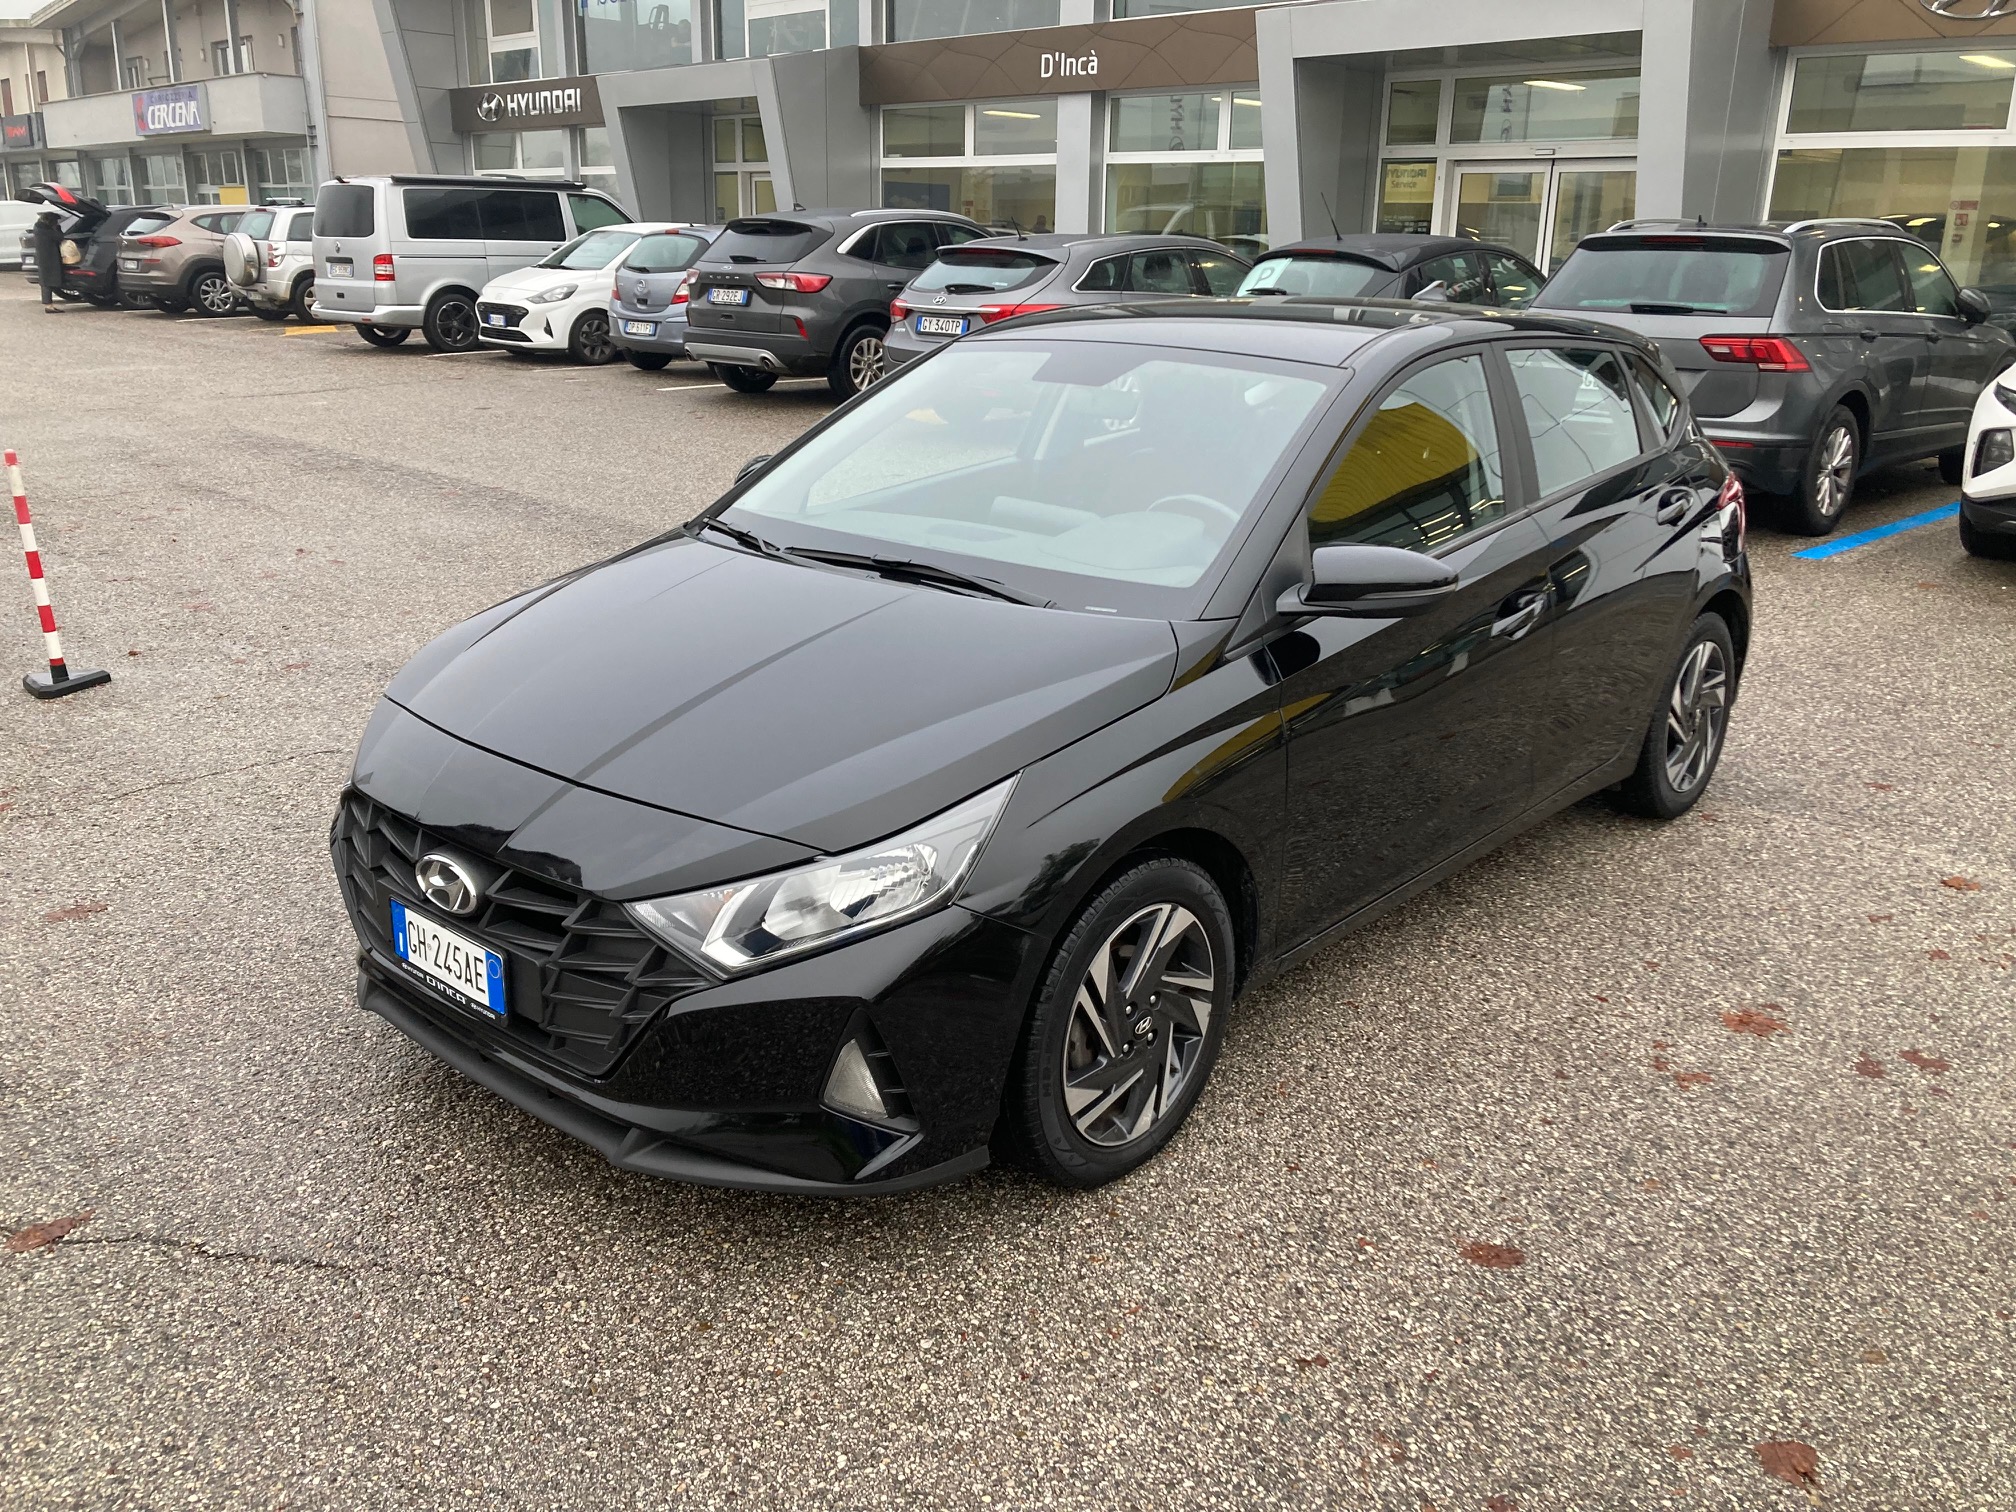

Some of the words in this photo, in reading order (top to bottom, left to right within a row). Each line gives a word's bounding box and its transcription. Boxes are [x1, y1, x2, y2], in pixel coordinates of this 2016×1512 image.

[1040, 49, 1098, 78] D'Incà
[147, 101, 200, 130] CERCENA
[506, 88, 581, 117] HYUNDAI
[922, 318, 933, 331] GY
[934, 319, 961, 333] 340TP
[407, 920, 428, 962] GH
[431, 934, 486, 995] 245AE
